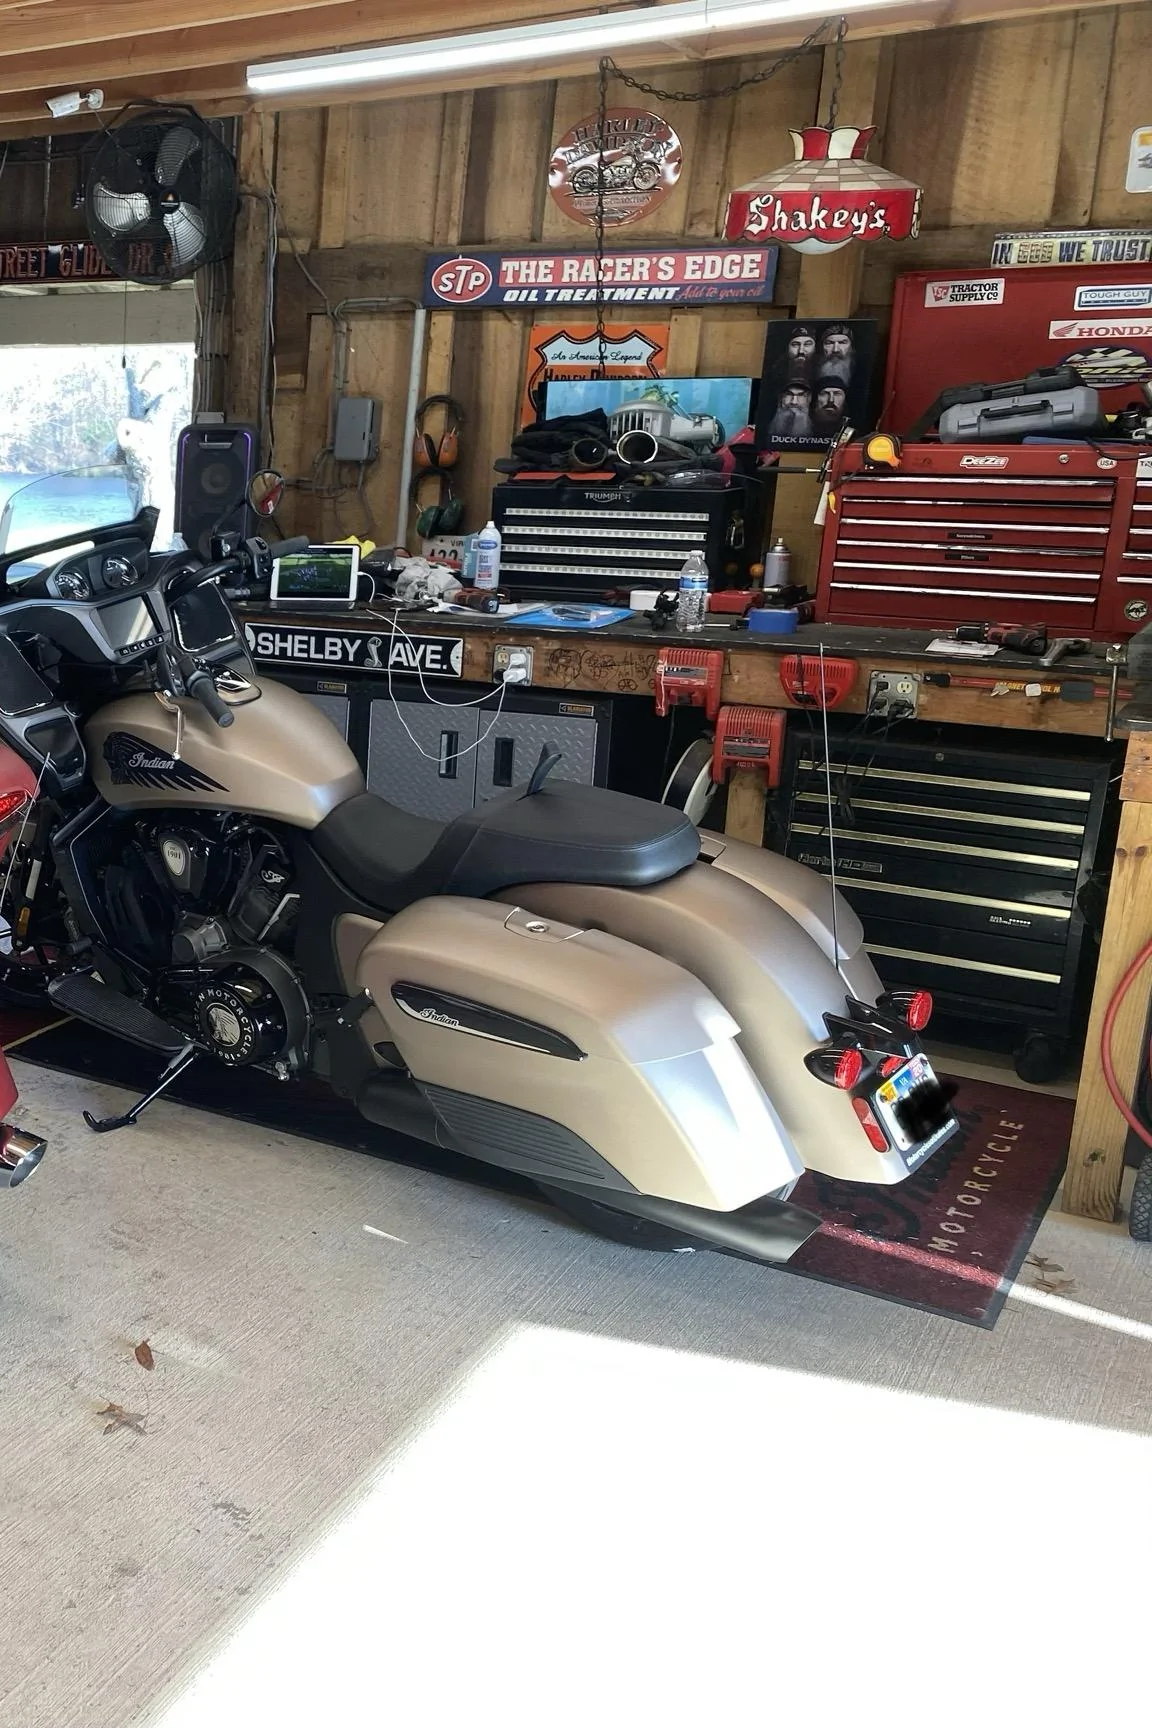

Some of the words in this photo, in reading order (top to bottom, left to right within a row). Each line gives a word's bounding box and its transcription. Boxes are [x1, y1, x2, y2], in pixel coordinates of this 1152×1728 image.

[745, 194, 886, 235] Shakey's
[993, 243, 1013, 264] IN
[1017, 242, 1054, 263] GOD
[1058, 240, 1087, 263] WE
[501, 260, 554, 284] THE
[561, 256, 675, 282] RACER'S
[684, 253, 762, 280] EDGE
[438, 265, 485, 295] STP
[951, 283, 998, 293] TRACTOR
[503, 289, 539, 302] OIL
[545, 286, 680, 302] TREATMENT
[949, 292, 986, 302] SUPPLY
[1124, 290, 1147, 298] GUY
[1077, 326, 1152, 337] HONDA
[551, 351, 566, 361] An
[568, 351, 608, 361] American
[610, 351, 643, 363] Legend
[771, 435, 797, 443] DUCK
[584, 492, 621, 500] TRIUMPH
[257, 632, 362, 662] SHELBY
[390, 642, 448, 669] AVE.
[128, 751, 175, 770] Indian
[207, 988, 252, 1055] MOTORCYCLE
[420, 1009, 459, 1026] Indian
[928, 1119, 1025, 1254] MOTORCYCLE
